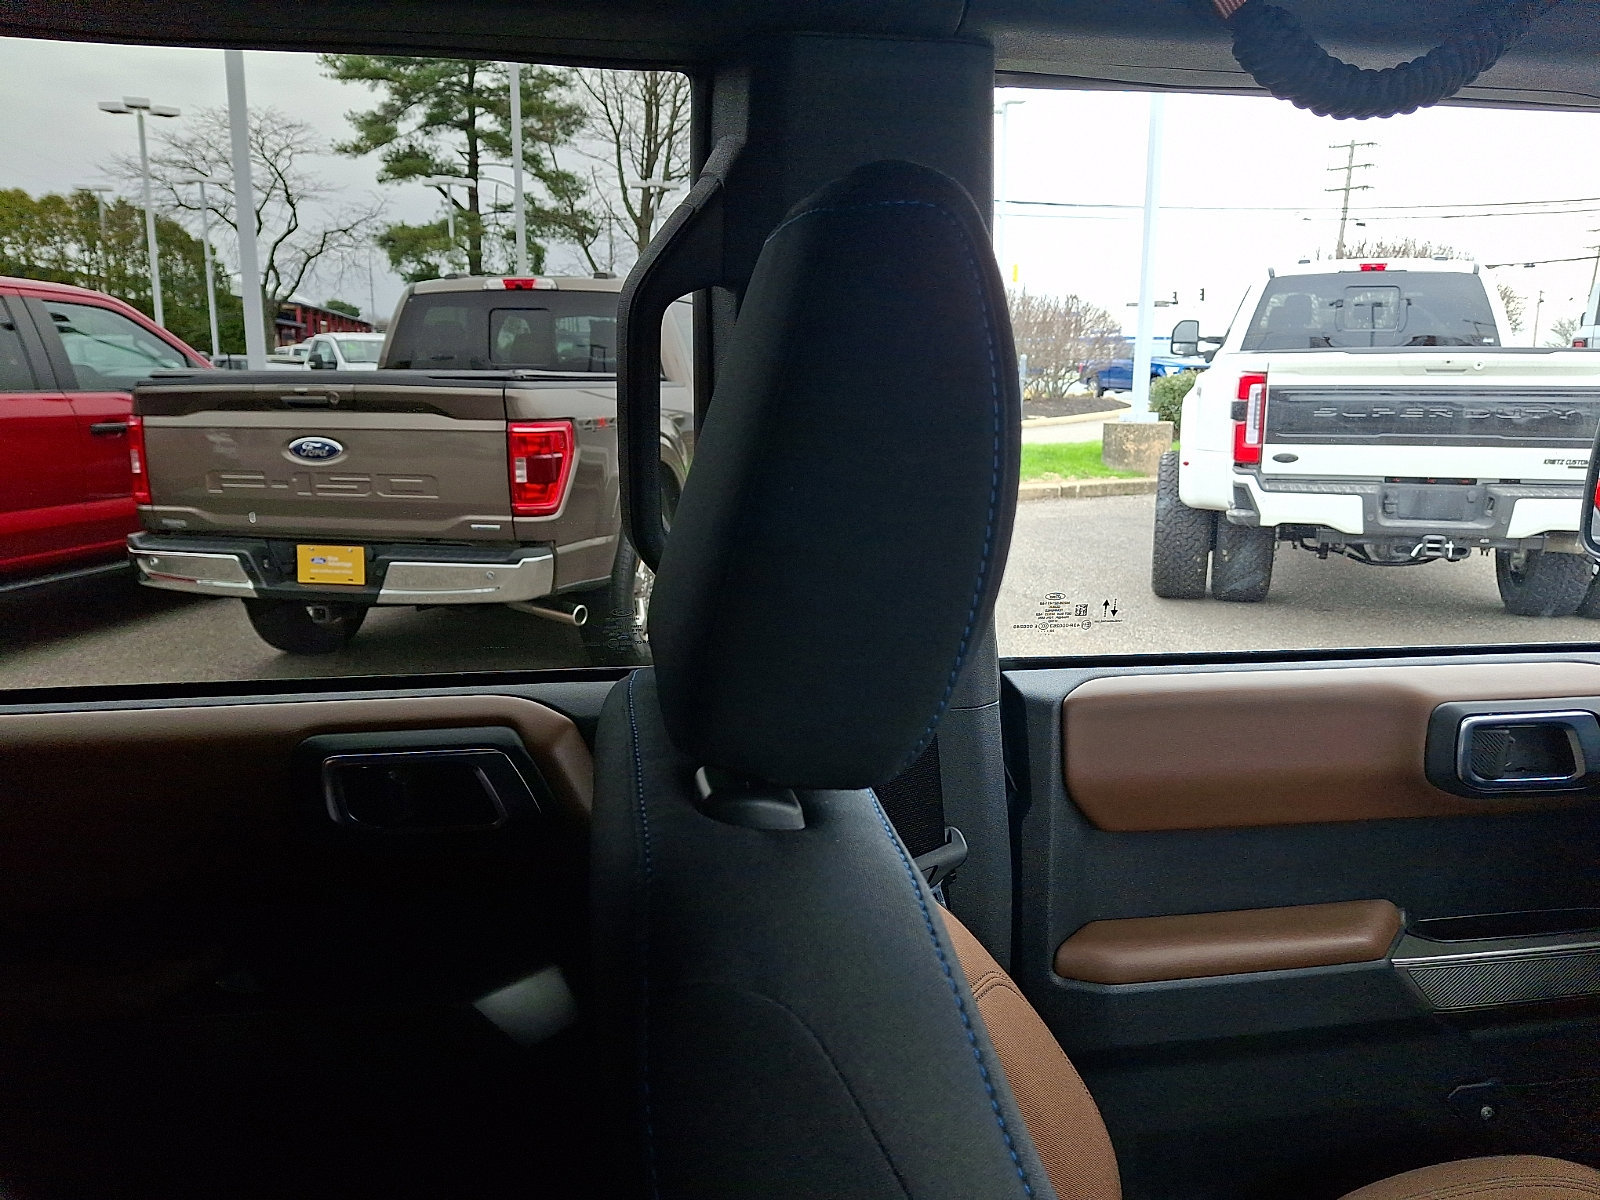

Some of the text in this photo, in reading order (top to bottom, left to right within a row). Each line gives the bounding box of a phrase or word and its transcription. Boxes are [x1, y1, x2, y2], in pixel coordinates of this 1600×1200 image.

[1312, 407, 1580, 421] SUPER DUTY
[206, 468, 439, 499] F-150
